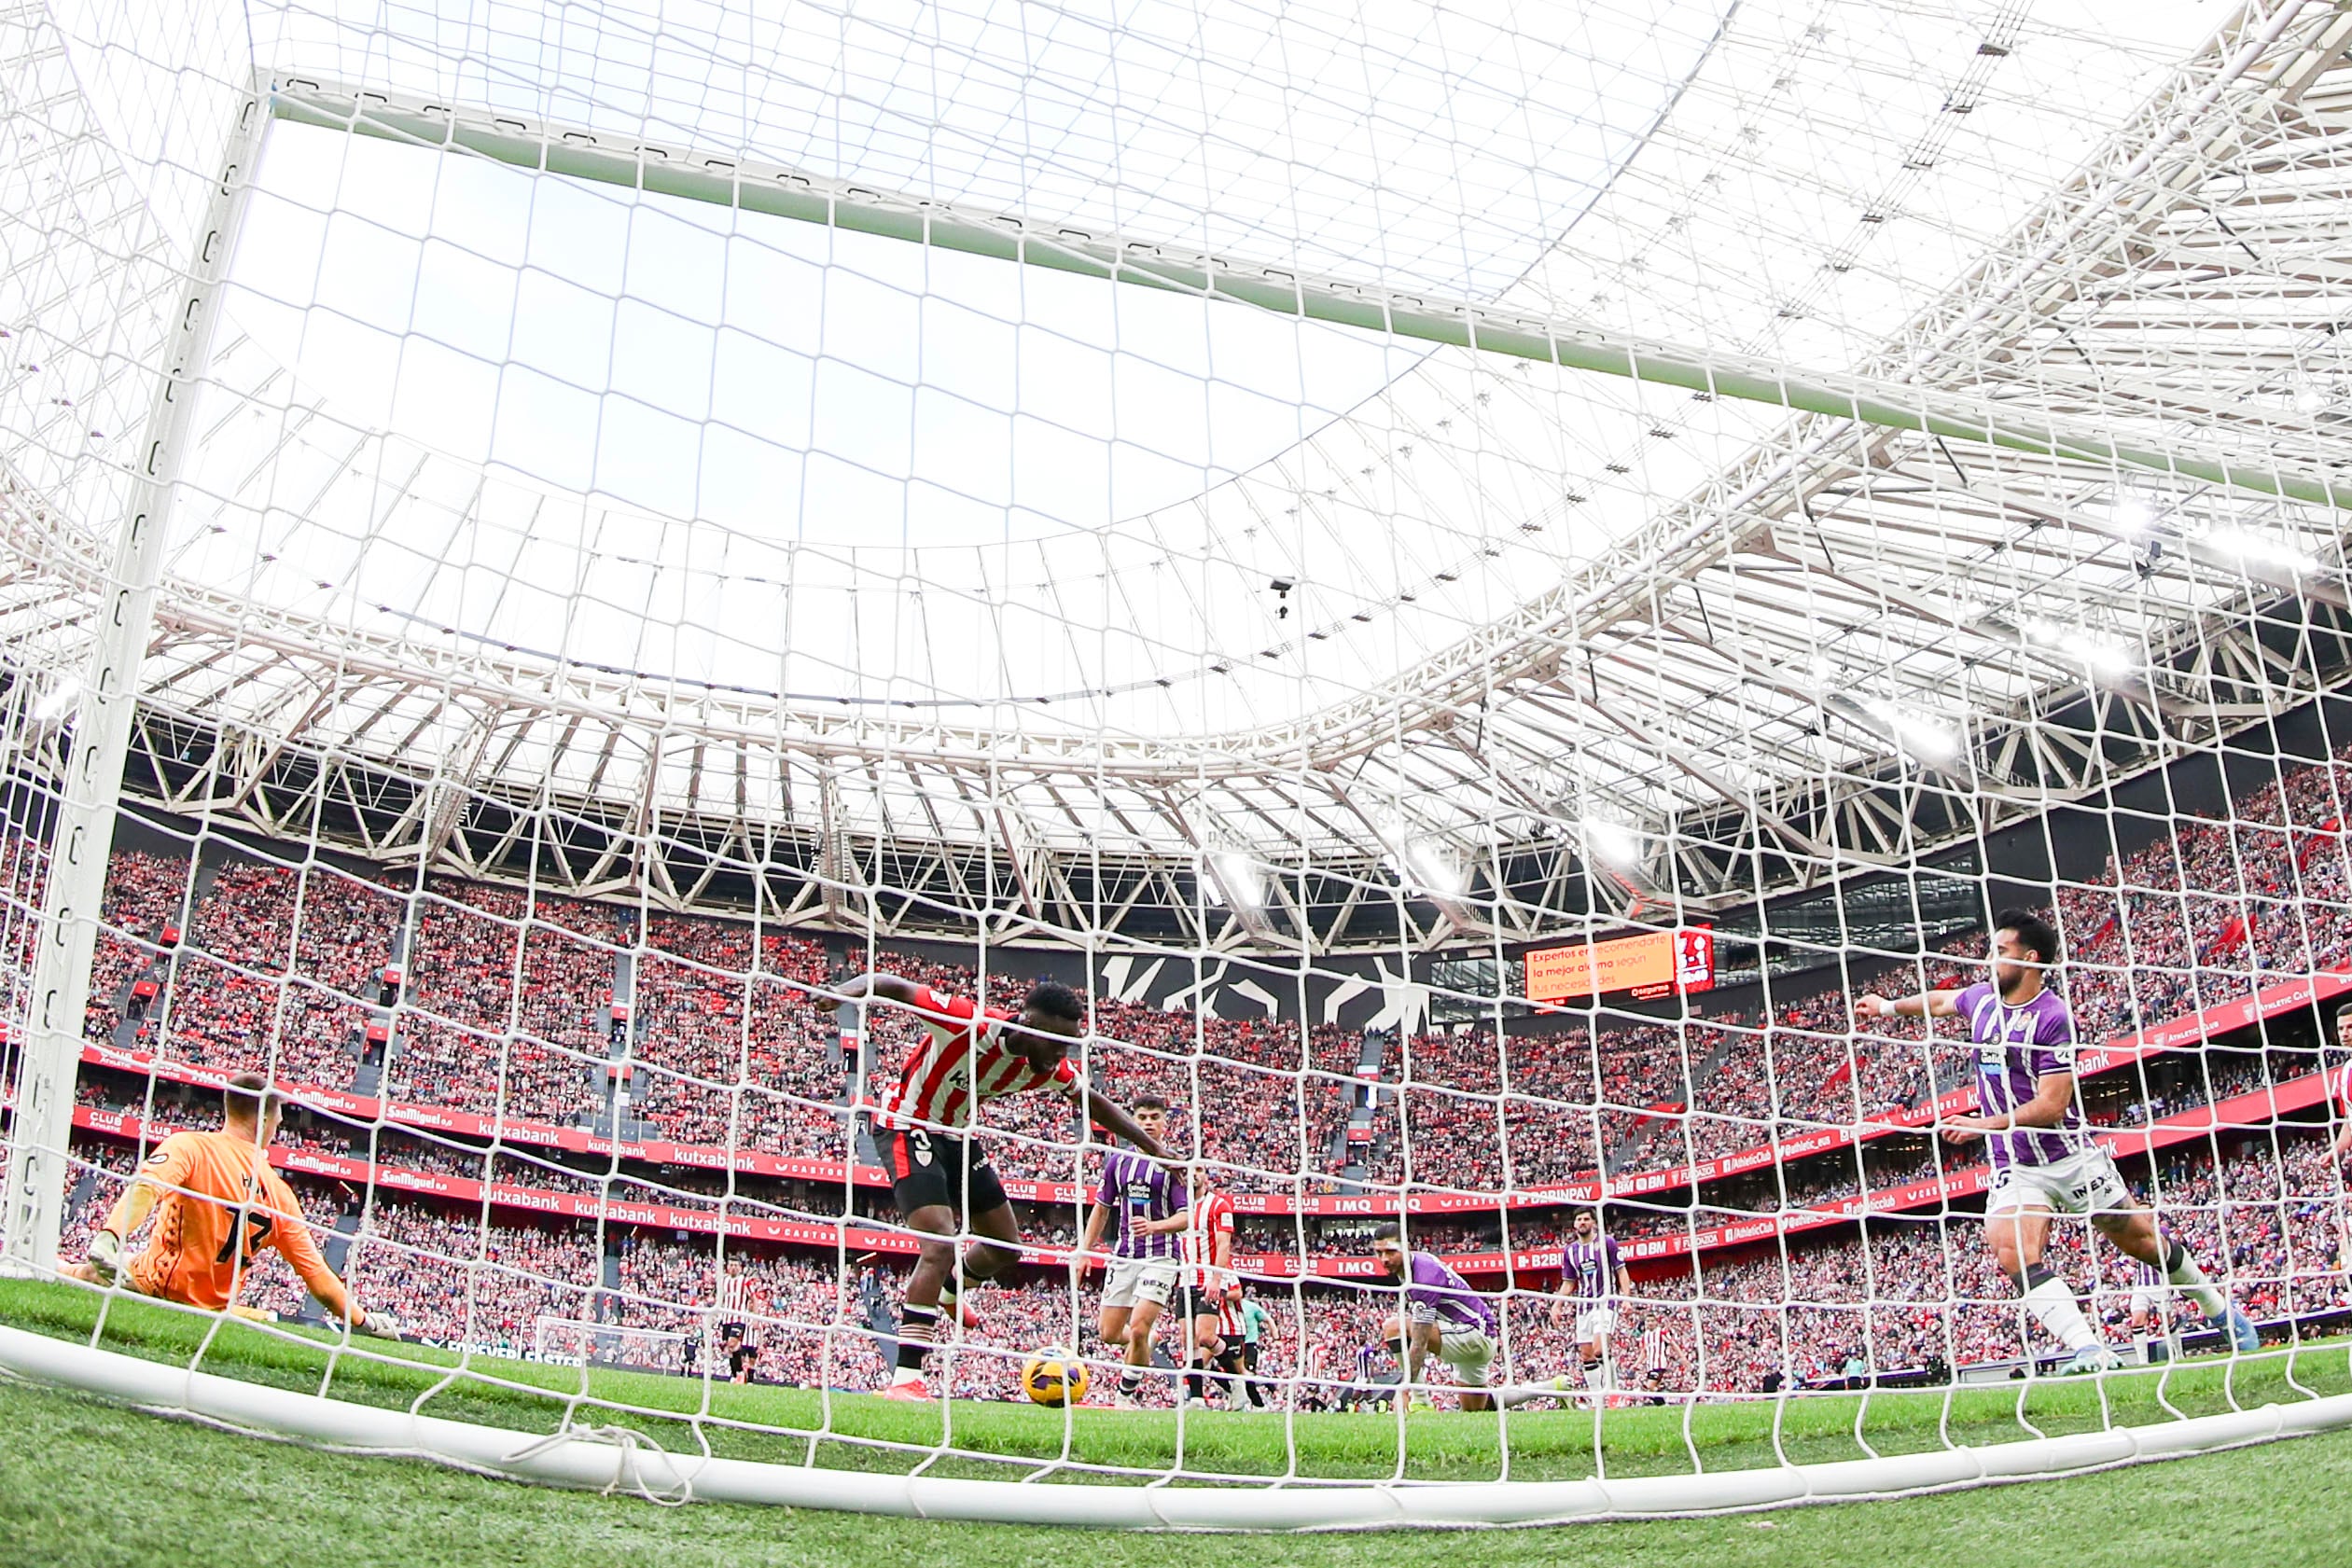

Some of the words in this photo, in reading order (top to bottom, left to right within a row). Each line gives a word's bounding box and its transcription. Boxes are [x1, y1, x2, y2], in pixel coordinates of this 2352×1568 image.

[1533, 951, 1576, 963] Expertos
[1533, 969, 1543, 978] la
[1546, 965, 1574, 977] mejor
[1551, 975, 1616, 992] necesiddes
[1914, 1098, 1957, 1118] CASORE
[90, 1112, 123, 1126] CLUB
[478, 1119, 560, 1145] kuxabank
[587, 1139, 647, 1159] kutxbank
[285, 1153, 341, 1173] SanMiguel
[675, 1148, 757, 1172] kutxabnk
[791, 1165, 845, 1178] CASTOR
[380, 1169, 436, 1190] SanMiguel
[1616, 1179, 1635, 1194] BM
[1648, 1174, 1666, 1189] BM
[1003, 1183, 1037, 1194] CLUB
[1918, 1180, 1964, 1199] CASORE
[1232, 1196, 1266, 1206] CLUB
[1286, 1197, 1319, 1206] CUB
[1335, 1200, 1373, 1214] IMQ
[785, 1228, 837, 1242] CASTOR
[1648, 1241, 1666, 1256] BM
[1231, 1257, 1265, 1268] CLUB
[1284, 1259, 1318, 1269] CLB
[1338, 1261, 1375, 1275] IMQ
[1456, 1259, 1505, 1270] CASTOR
